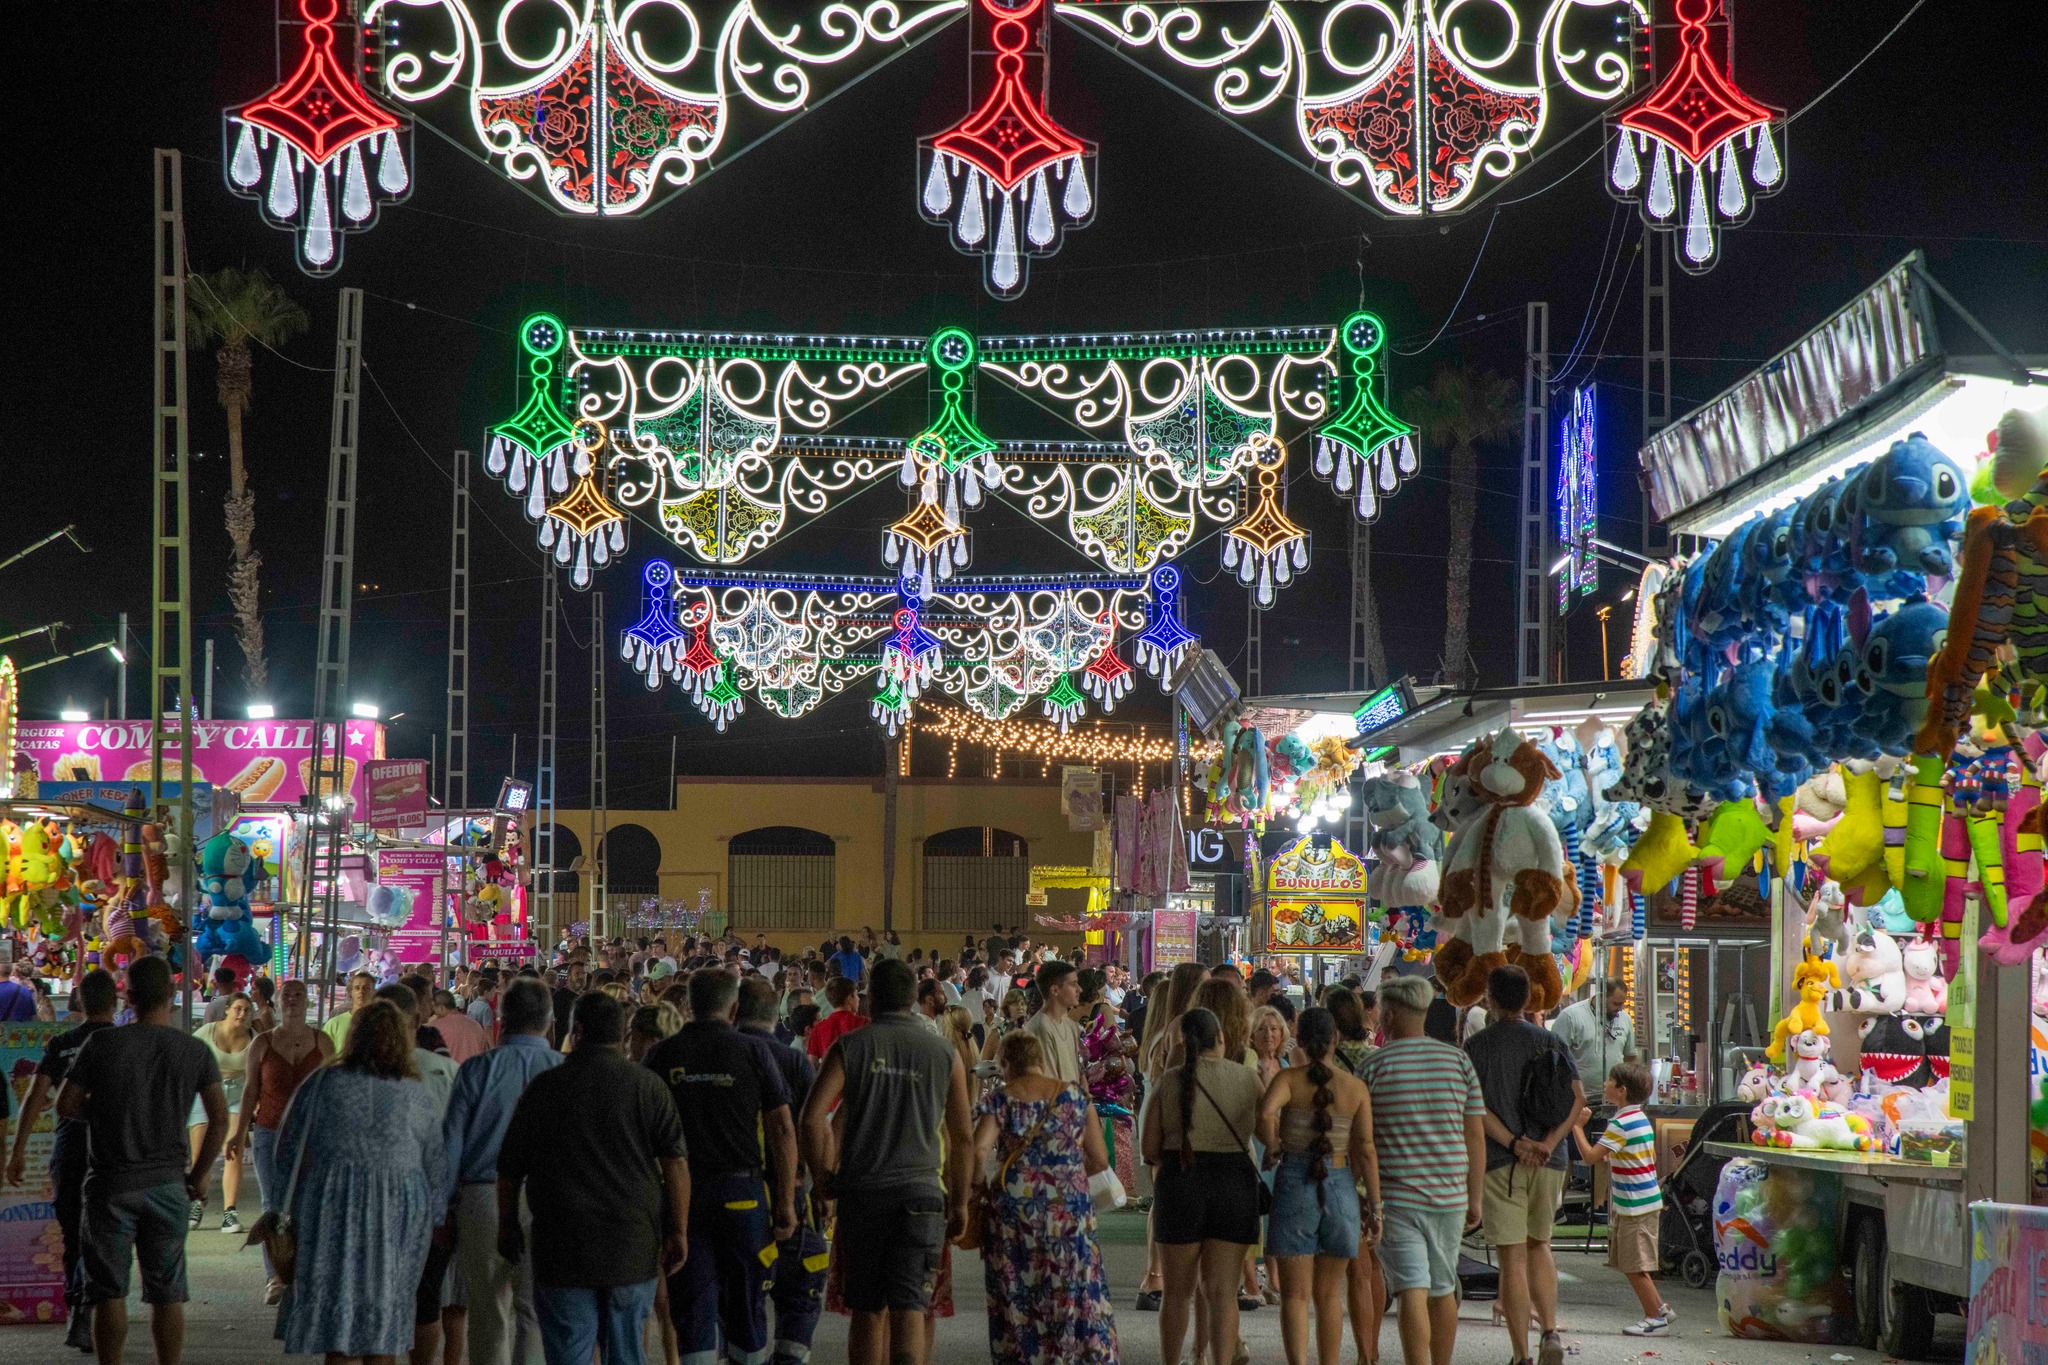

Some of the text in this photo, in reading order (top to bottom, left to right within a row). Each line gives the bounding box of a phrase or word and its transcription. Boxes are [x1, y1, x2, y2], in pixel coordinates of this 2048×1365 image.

[76, 726, 337, 750] COME Y CALLA
[372, 762, 423, 781] OFERTÓN
[399, 813, 422, 825] 6.00€
[1275, 876, 1363, 889] BUÑUELOS
[482, 948, 525, 957] TAQUILLA
[0, 1202, 58, 1222] ONNER
